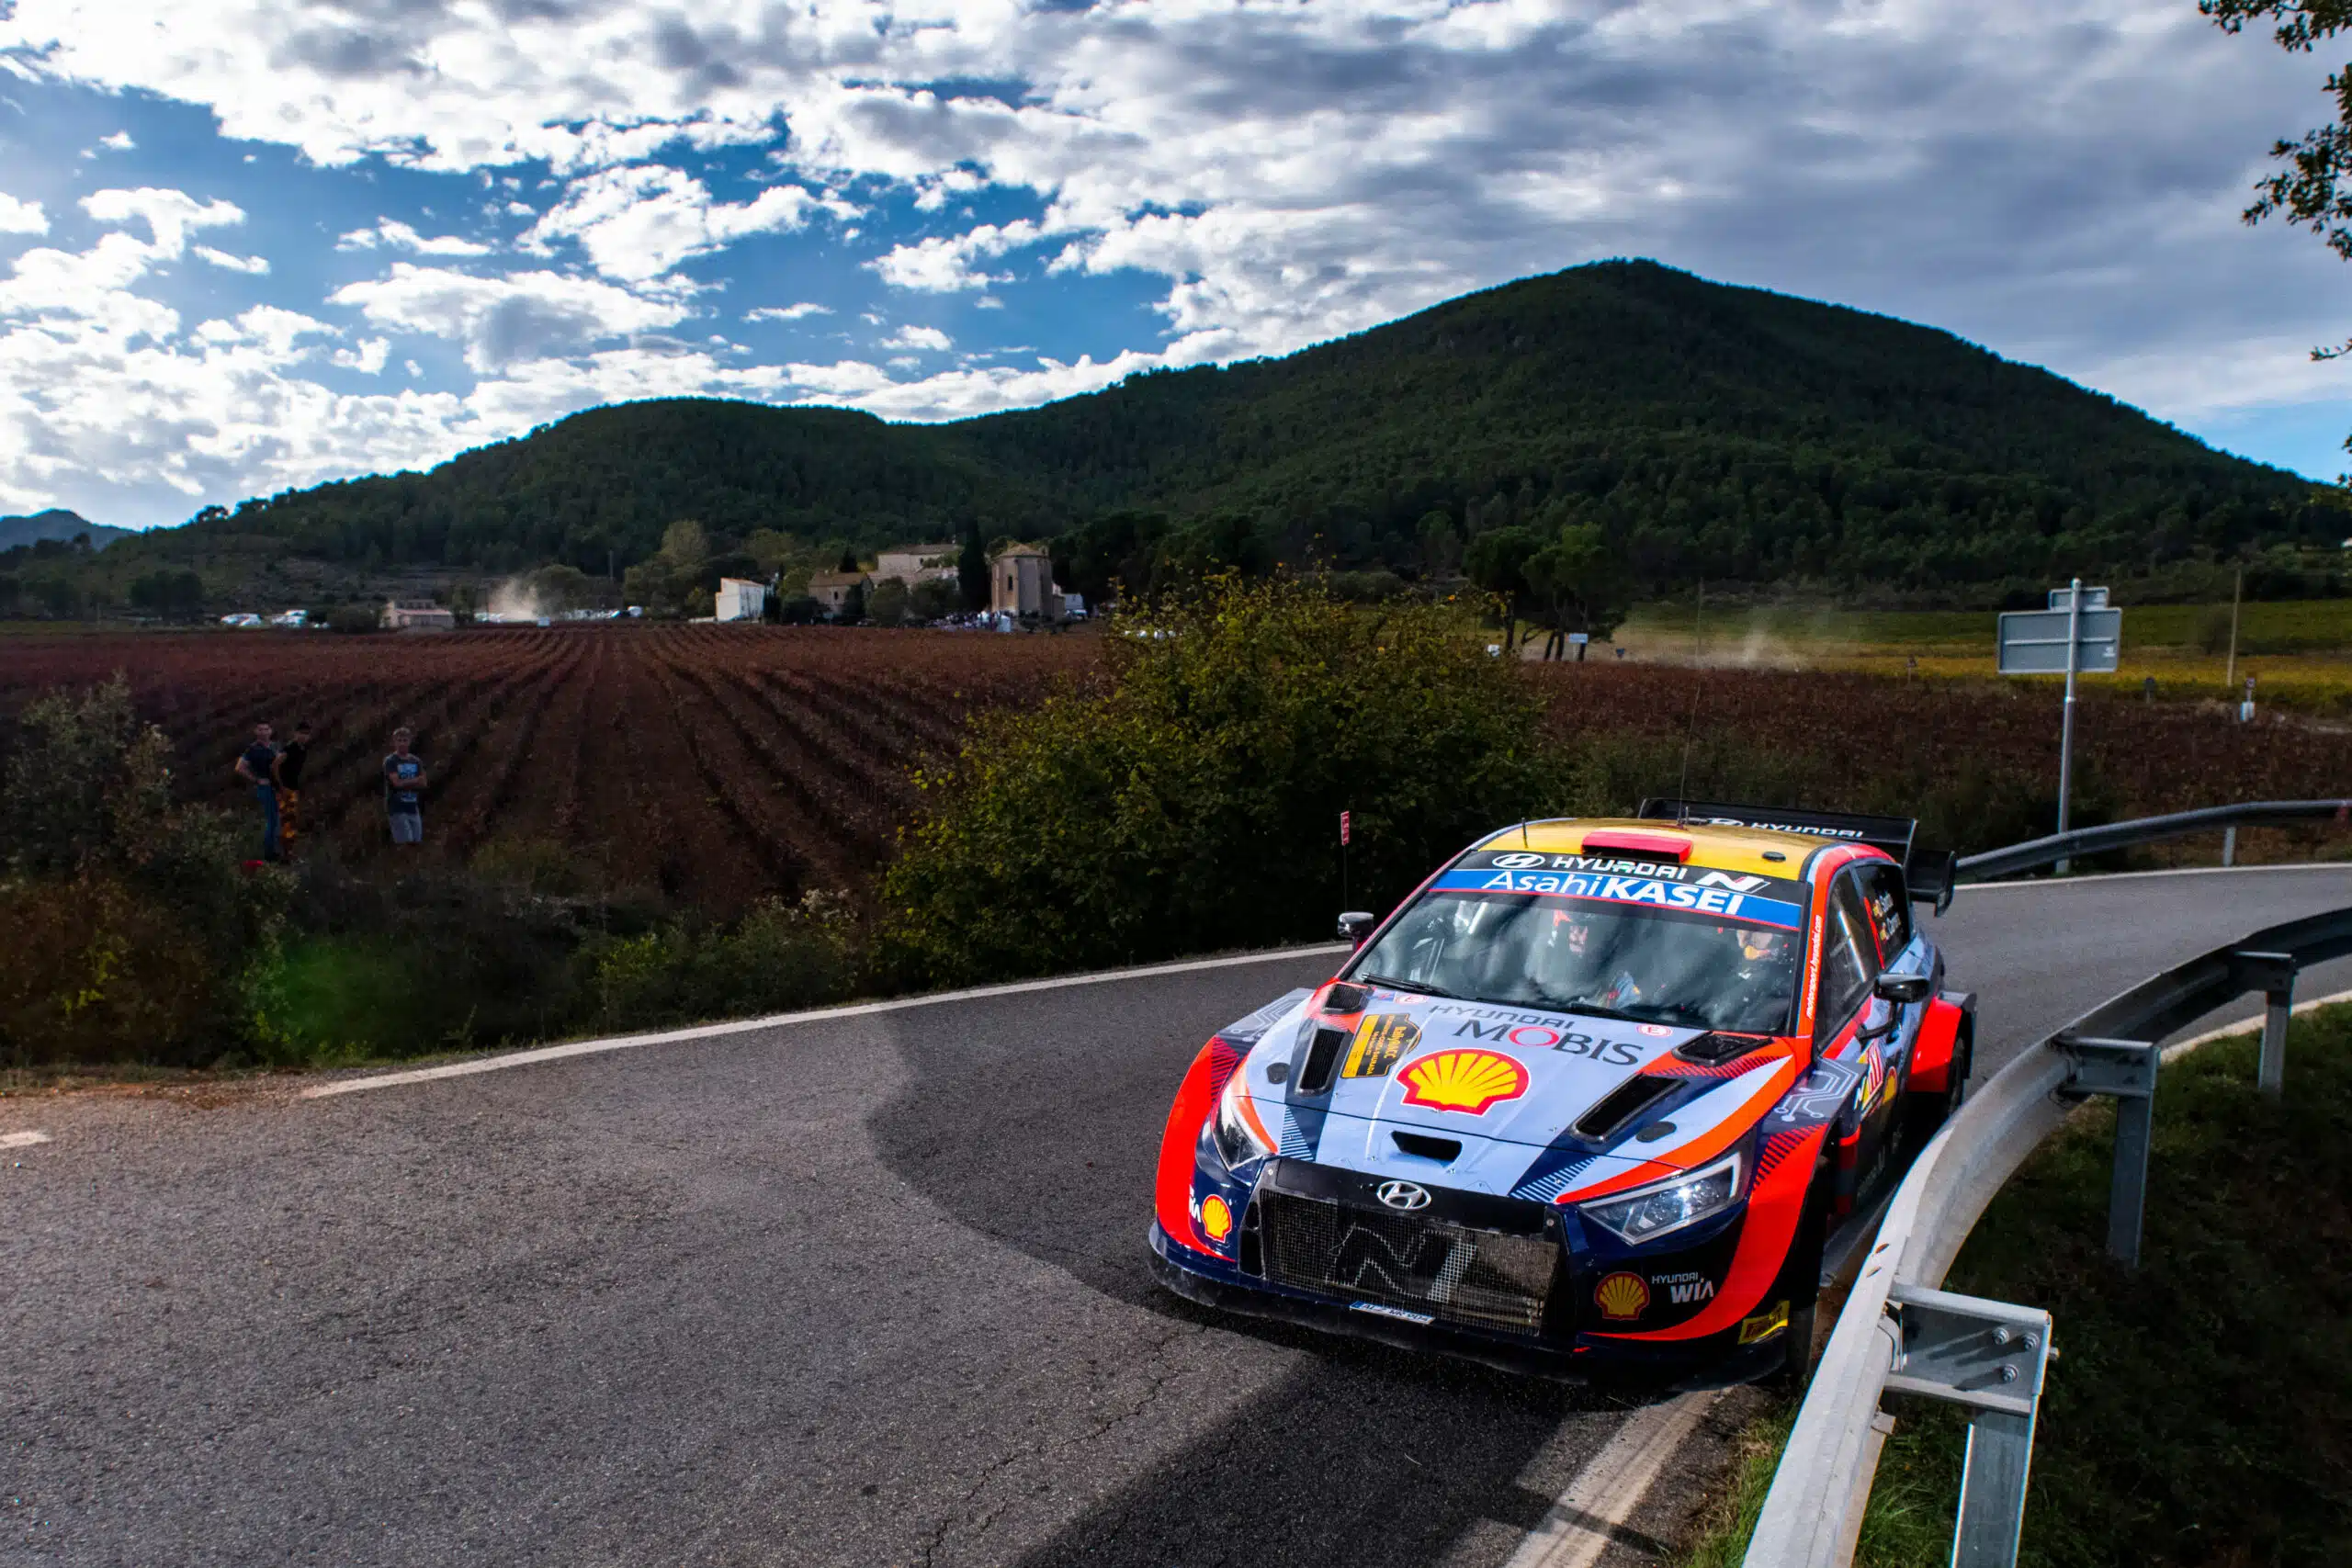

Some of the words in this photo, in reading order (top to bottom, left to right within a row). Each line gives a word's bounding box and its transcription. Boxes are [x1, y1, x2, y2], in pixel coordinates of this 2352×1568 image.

[1750, 821, 1864, 839] HYUNDAI
[1552, 855, 1688, 880] HYUNDAI
[1430, 1004, 1576, 1030] HYUNDAI
[1452, 1018, 1645, 1066] MOBIS
[1651, 1271, 1699, 1284] HYUNDAI
[1670, 1277, 1714, 1303] WIA
